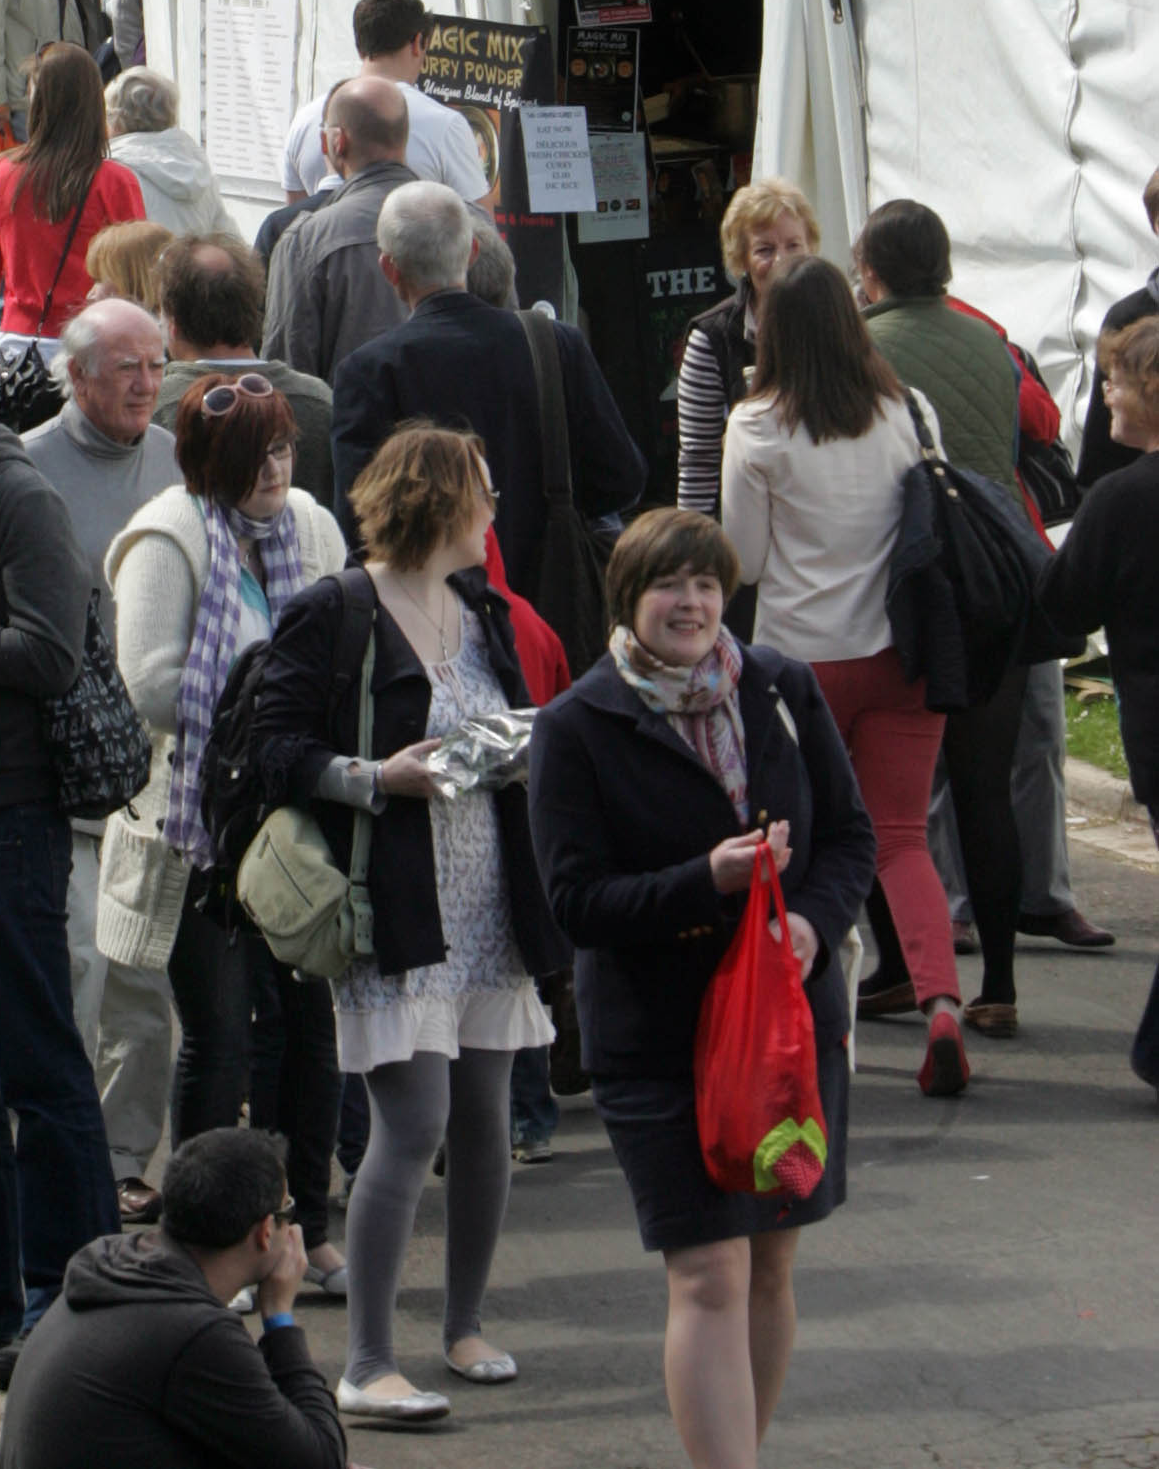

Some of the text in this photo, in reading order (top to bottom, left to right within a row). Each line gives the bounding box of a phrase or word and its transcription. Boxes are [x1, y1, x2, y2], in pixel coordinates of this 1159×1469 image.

[428, 23, 525, 64] AGIC MIX
[421, 55, 523, 89] URRY POWDER
[423, 79, 461, 102] Unique
[464, 85, 492, 103] Blend
[493, 90, 503, 110] of
[646, 266, 716, 298] THE
